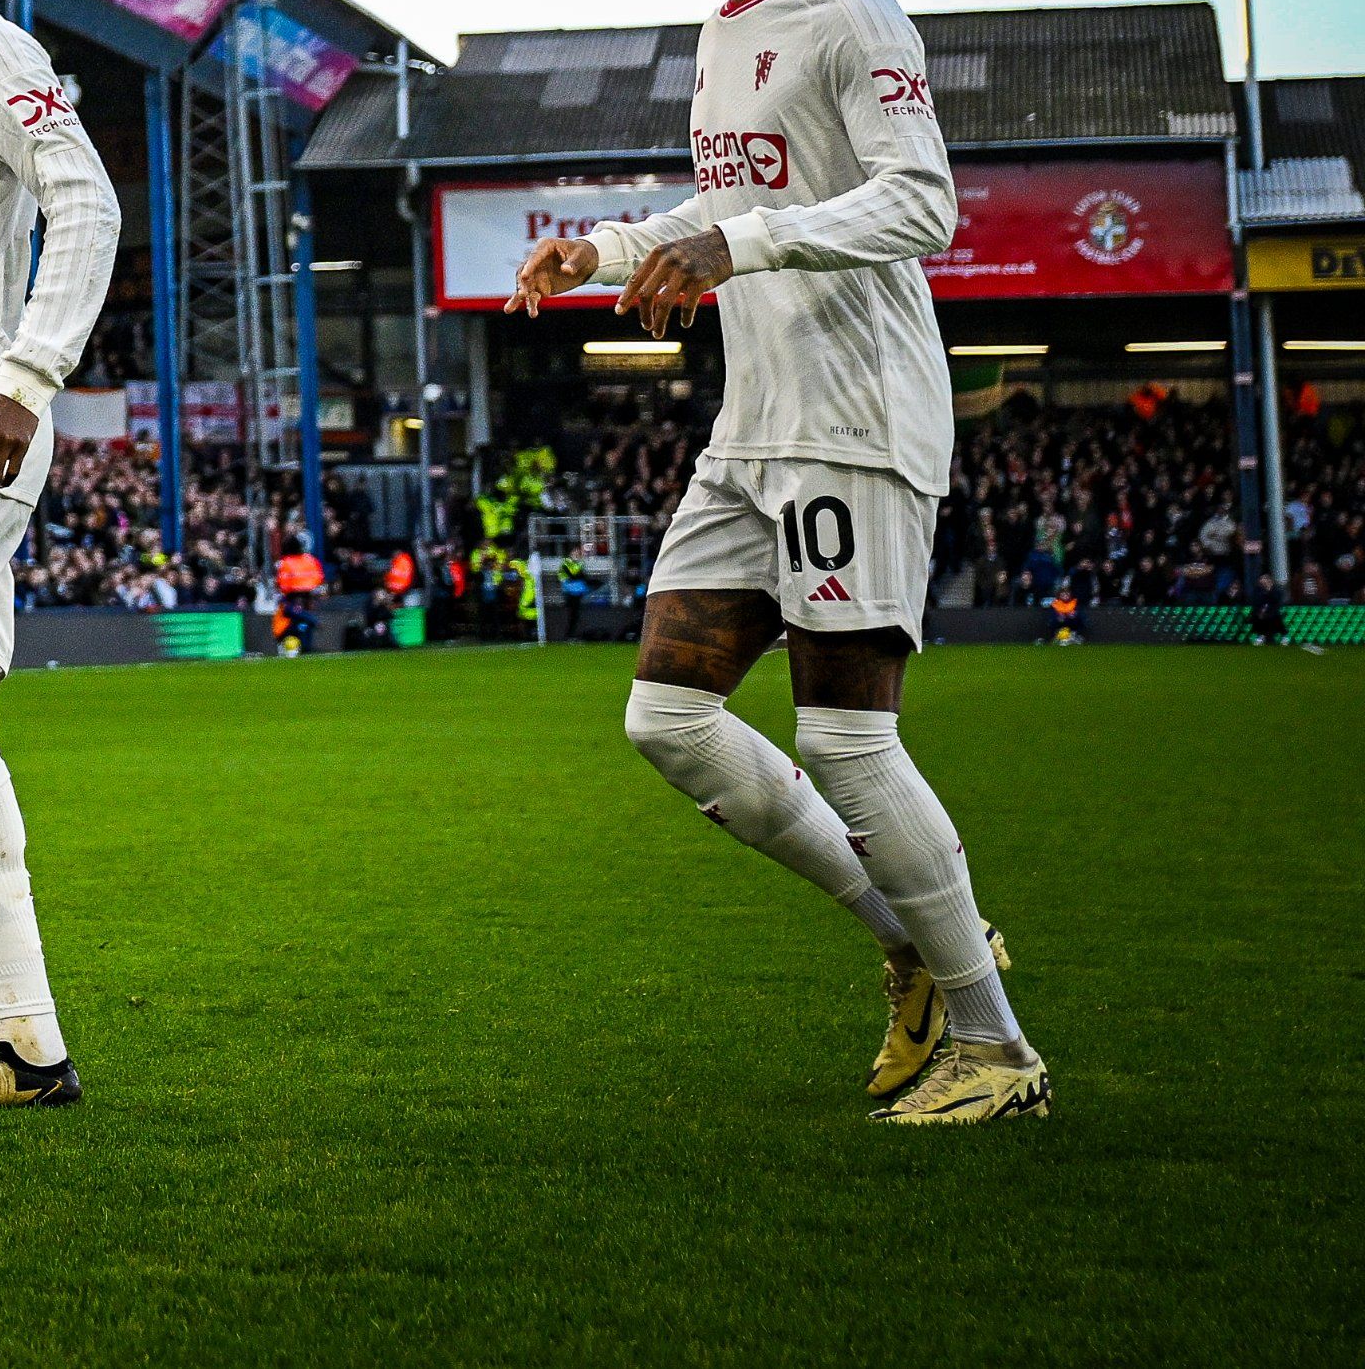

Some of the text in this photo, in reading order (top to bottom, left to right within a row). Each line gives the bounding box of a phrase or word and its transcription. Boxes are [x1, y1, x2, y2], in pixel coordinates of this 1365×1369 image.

[693, 128, 743, 162] Team
[694, 161, 746, 194] iewer
[779, 495, 856, 573] 10
